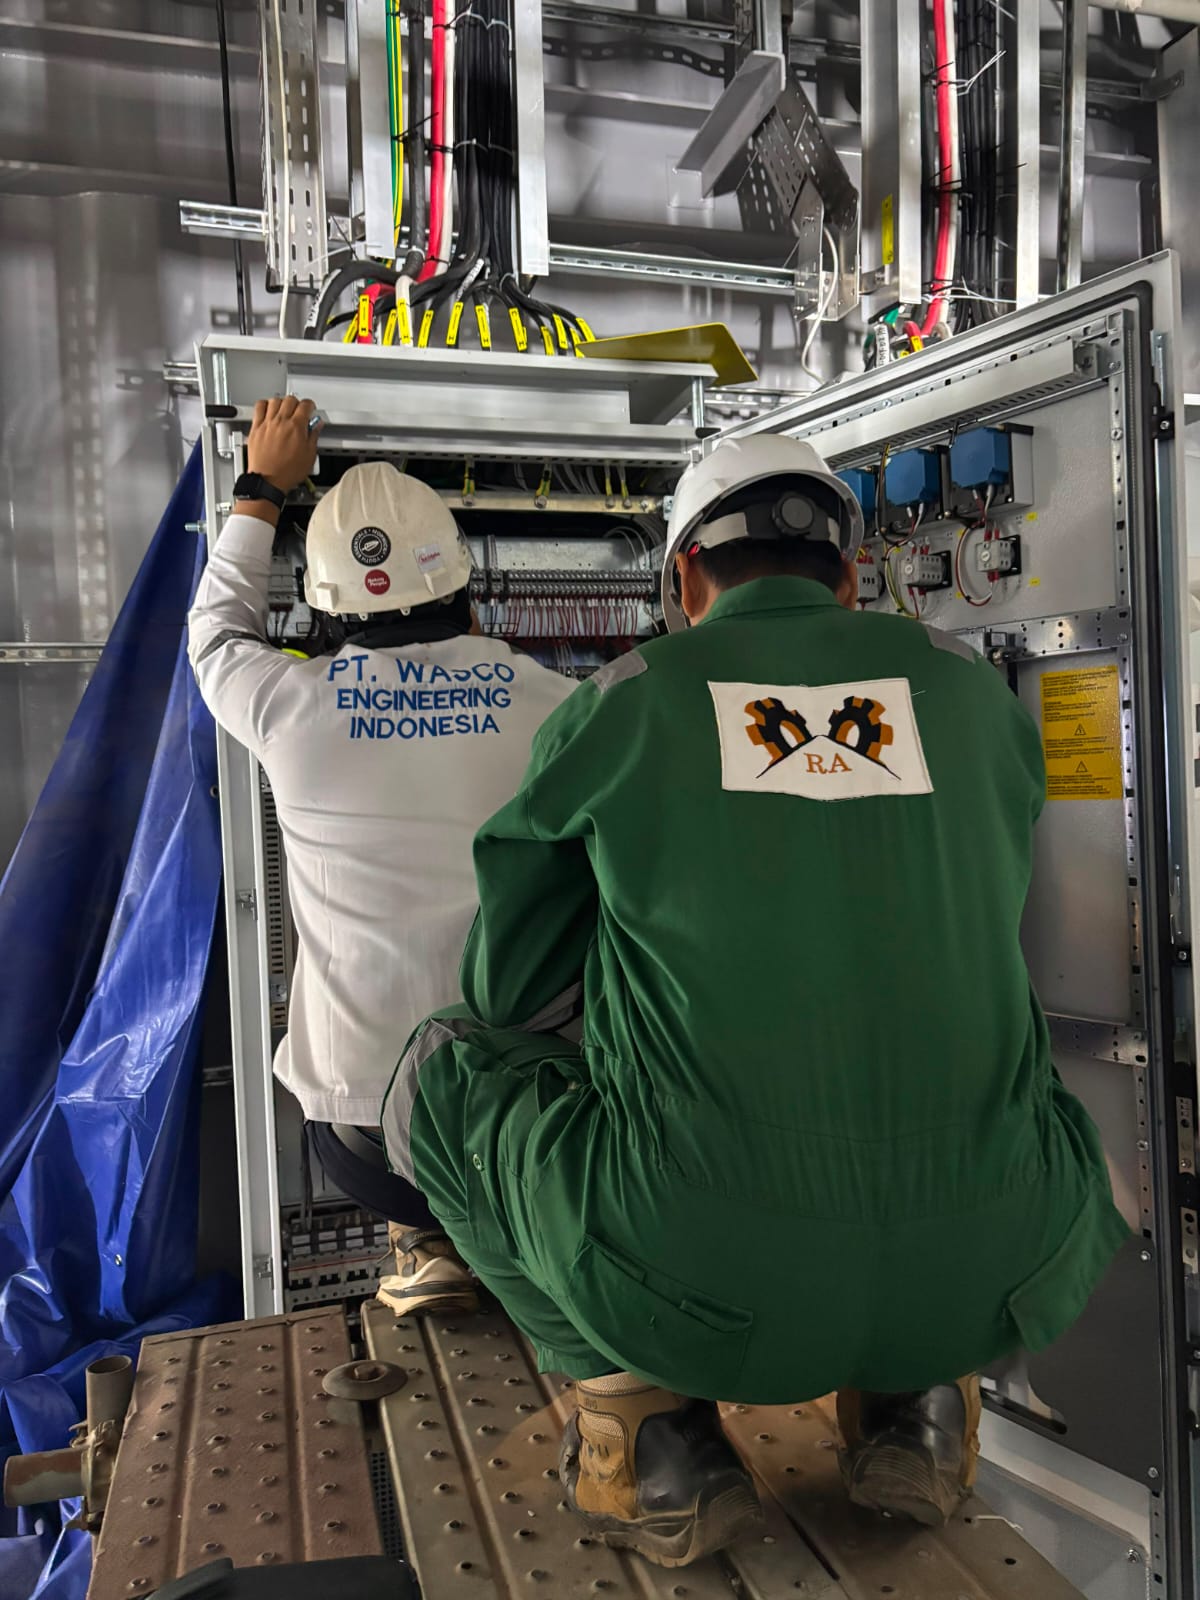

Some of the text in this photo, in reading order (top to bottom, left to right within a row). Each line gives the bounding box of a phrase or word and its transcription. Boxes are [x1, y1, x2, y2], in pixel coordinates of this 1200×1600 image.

[327, 654, 377, 682] PT.
[336, 687, 512, 711] ENGINEERING
[349, 713, 501, 740] INDONESIA
[803, 752, 852, 775] RA
